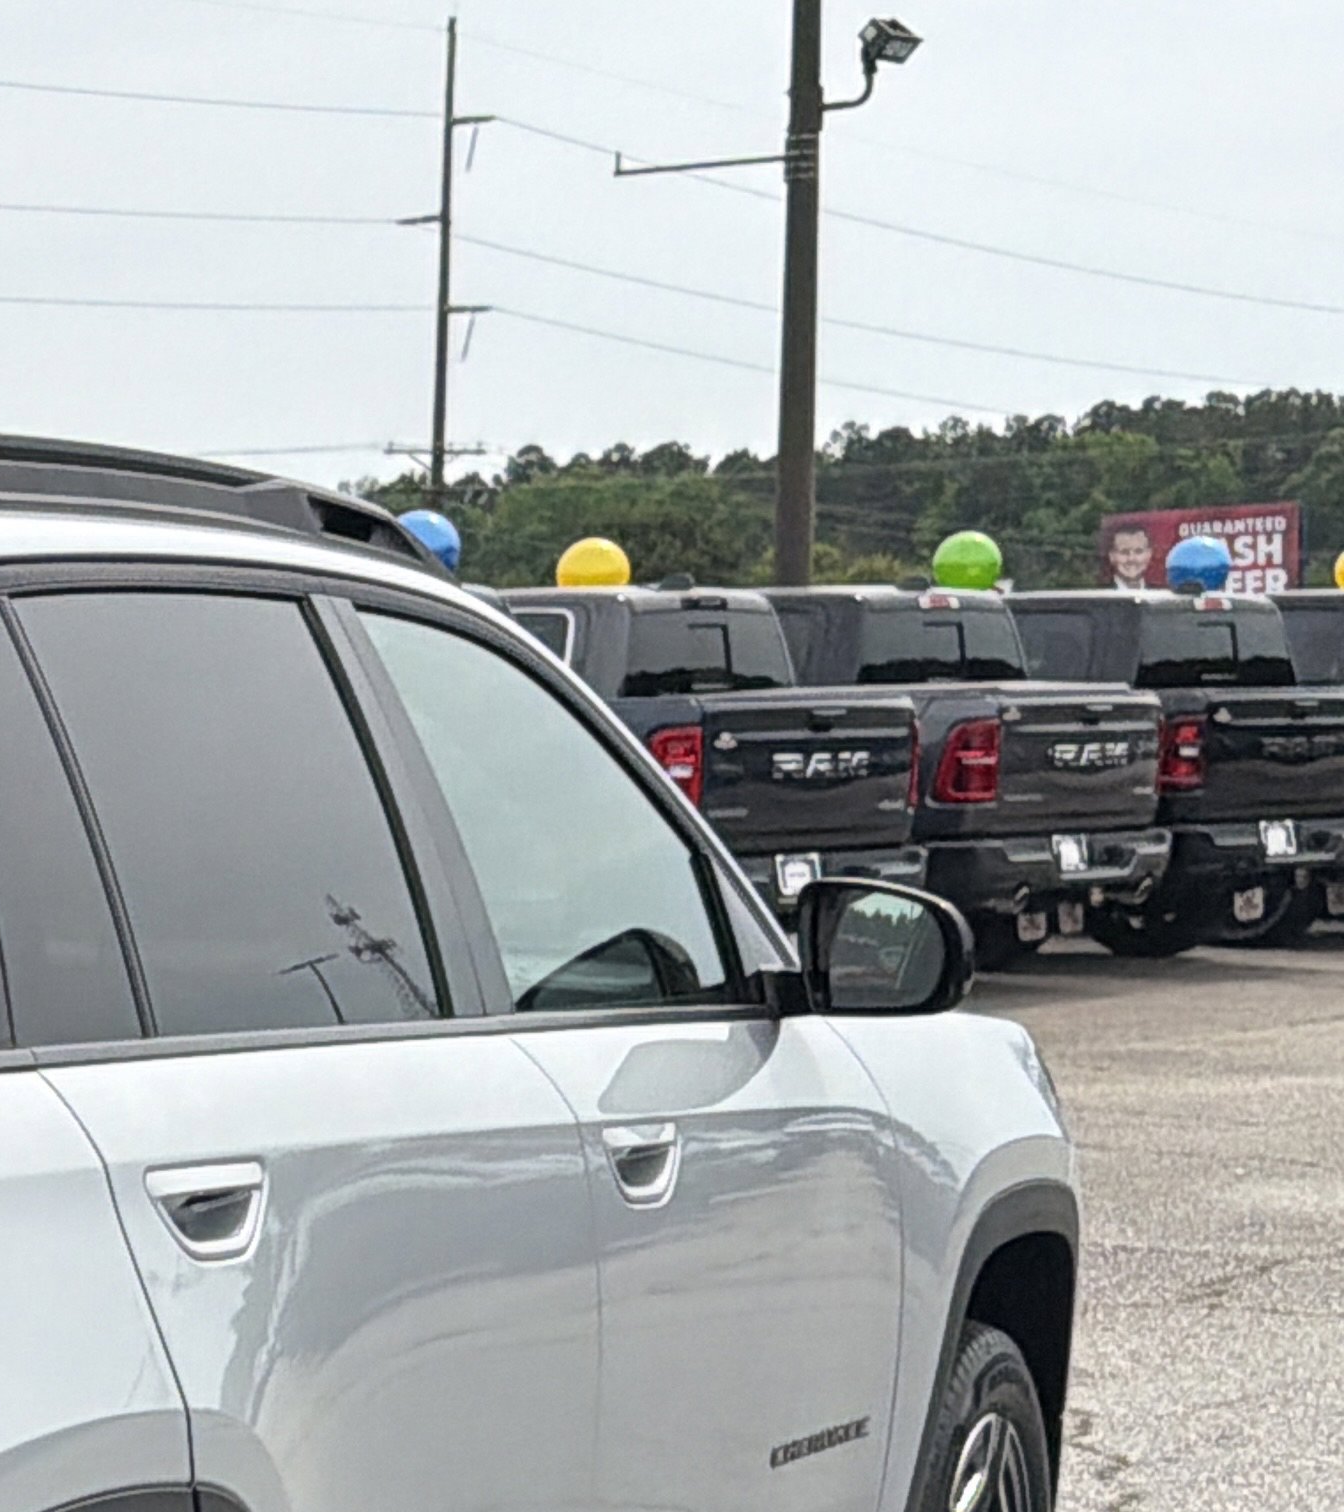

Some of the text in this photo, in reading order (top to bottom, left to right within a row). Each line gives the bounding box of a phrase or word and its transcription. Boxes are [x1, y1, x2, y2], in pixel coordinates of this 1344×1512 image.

[1178, 515, 1288, 537] GUARANTEED
[771, 751, 870, 780] RAM
[1052, 742, 1129, 767] RAM
[770, 1415, 871, 1469] CHEROKEE
